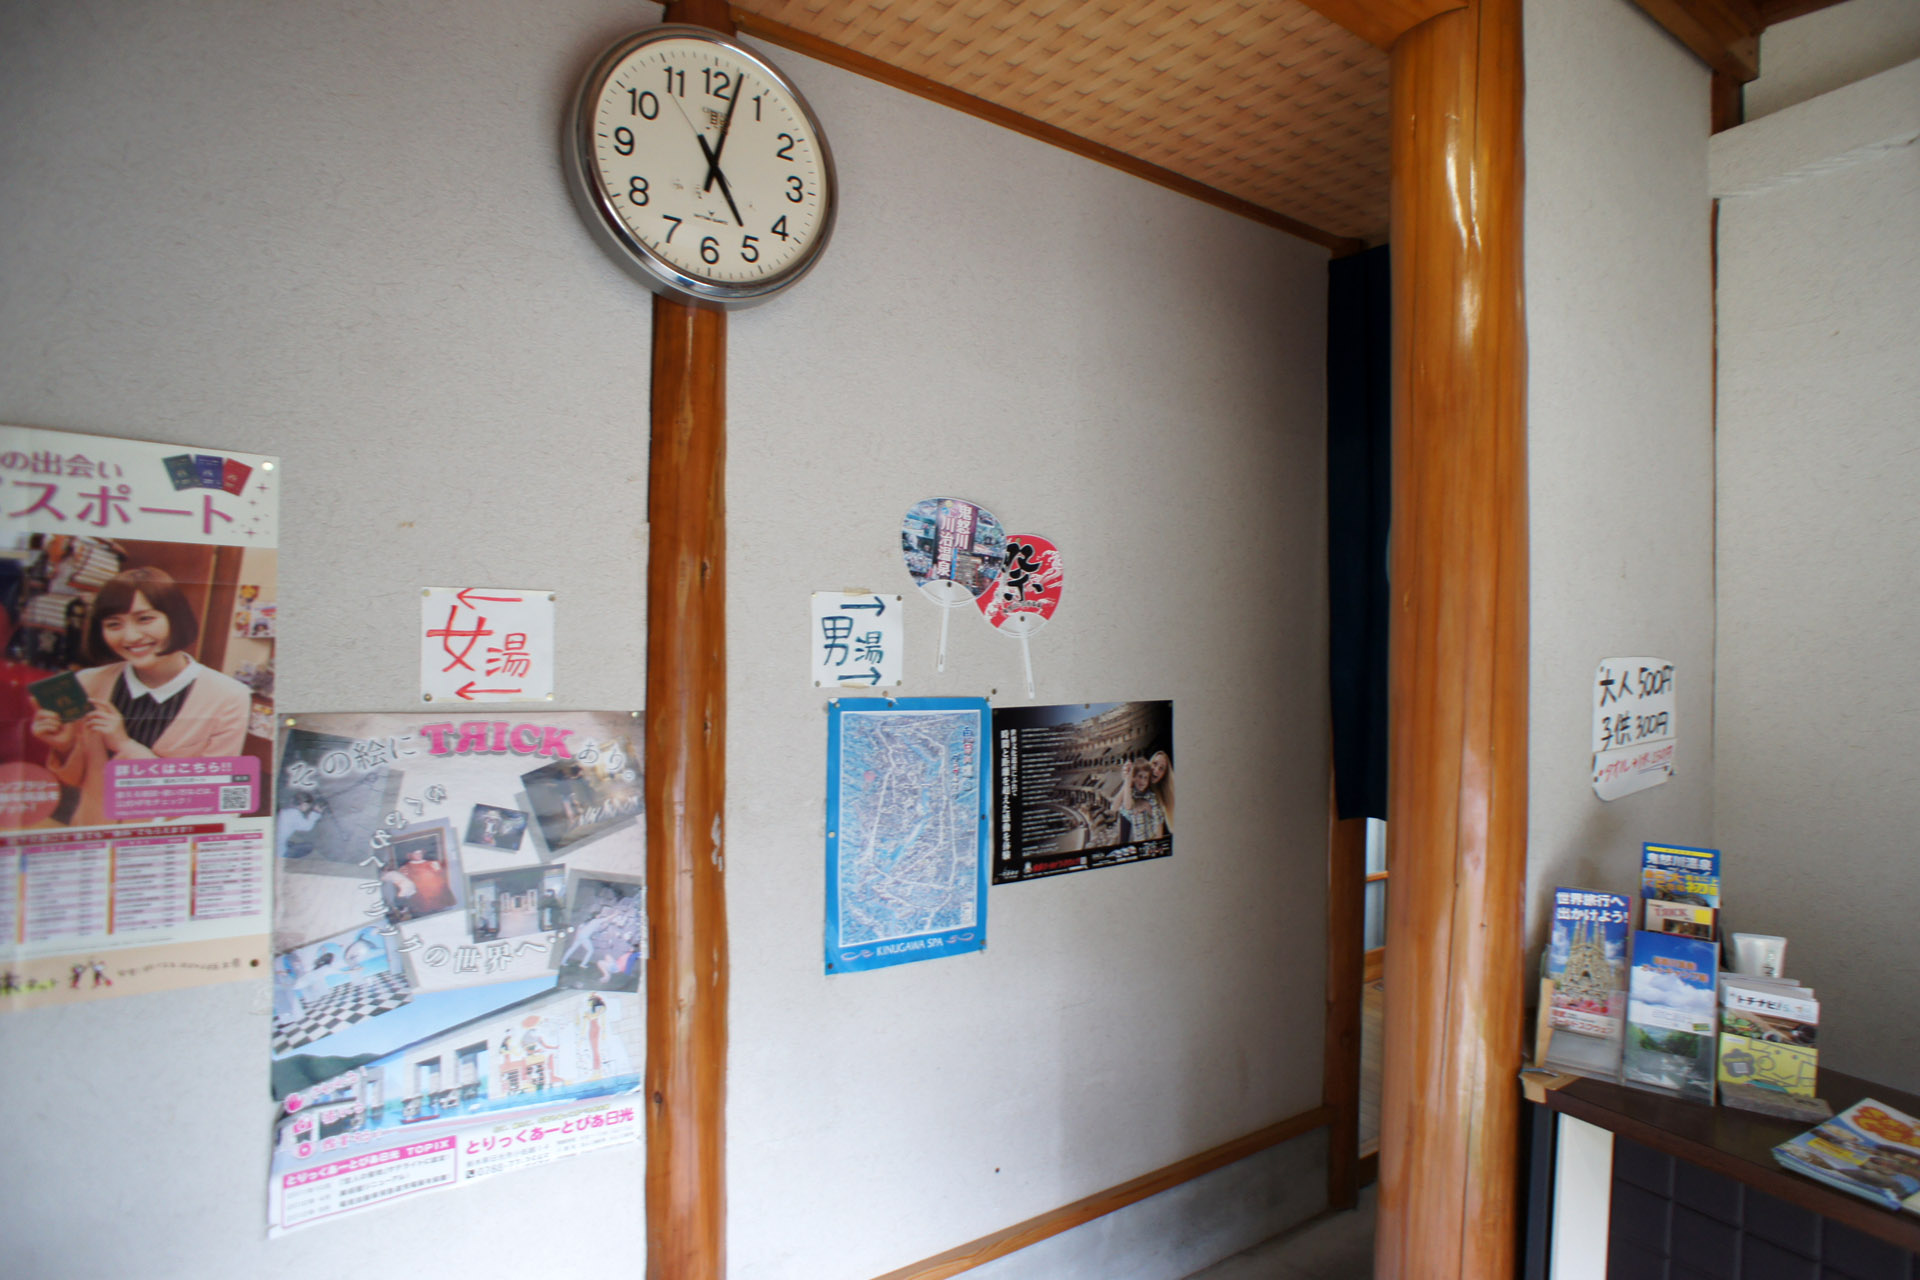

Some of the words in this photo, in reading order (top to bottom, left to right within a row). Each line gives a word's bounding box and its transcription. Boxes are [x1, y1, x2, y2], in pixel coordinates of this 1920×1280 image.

[664, 66, 685, 97] 11
[702, 67, 731, 101] 12
[627, 87, 659, 120] 10
[752, 95, 761, 121] 1
[614, 126, 635, 156] 9
[776, 133, 794, 161] 2
[629, 176, 649, 206] 8
[785, 175, 803, 203] 3
[662, 214, 682, 243] 7
[771, 215, 789, 241] 4
[700, 236, 719, 264] 6
[741, 235, 759, 263] 5
[0, 450, 122, 479] の出会い
[0, 478, 233, 535] スポート
[426, 605, 532, 677] 女湯
[821, 615, 885, 667] 男湯
[1599, 668, 1633, 707] 大人
[421, 721, 576, 760] TRICK
[876, 939, 926, 957] KINUGAWA
[927, 937, 944, 949] SPA
[466, 1107, 635, 1155] とりっくあーとぴあ日光
